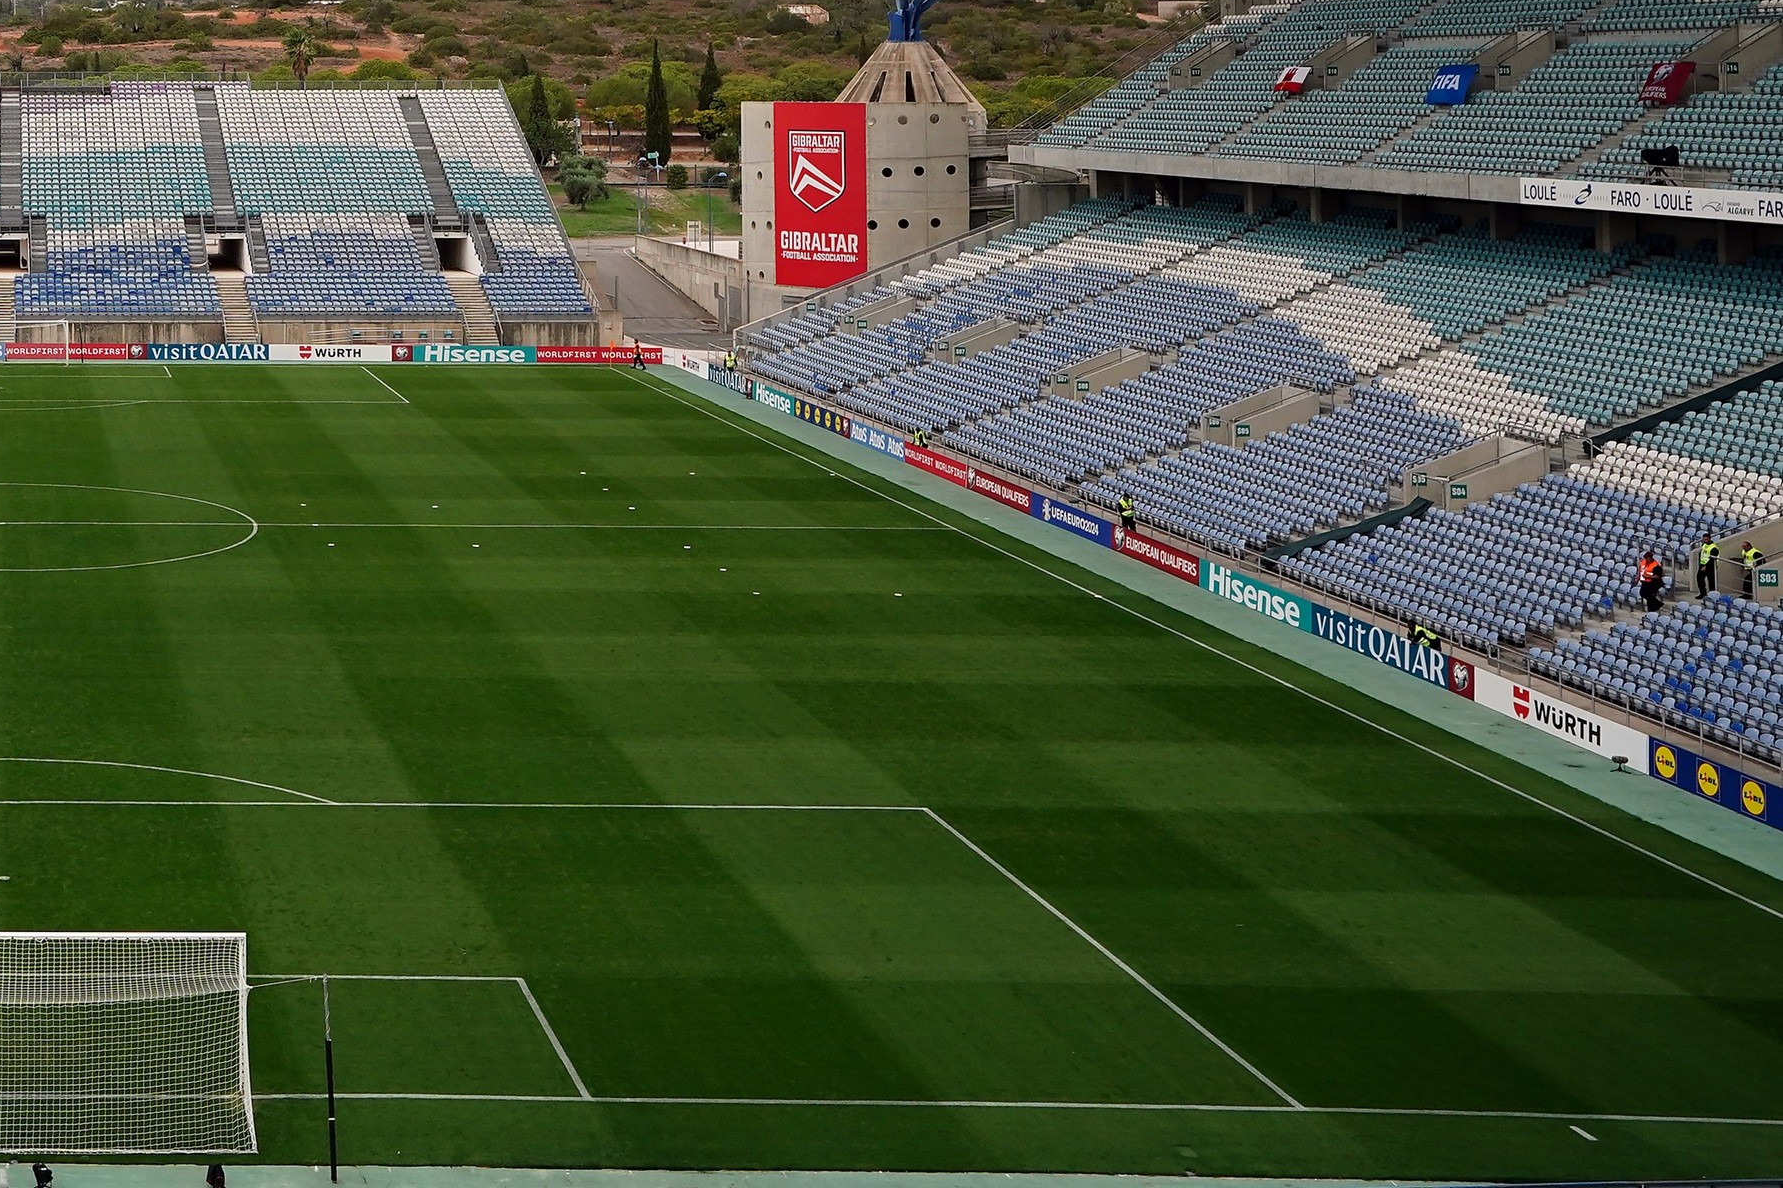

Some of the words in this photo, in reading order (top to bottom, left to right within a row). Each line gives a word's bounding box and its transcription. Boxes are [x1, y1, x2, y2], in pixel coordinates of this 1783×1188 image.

[1431, 74, 1460, 90] FIFA
[792, 134, 840, 148] GIBRALTAR
[1523, 182, 1557, 201] LOULÉ
[1610, 190, 1641, 208] FARO
[1654, 190, 1693, 211] LOULÉ
[1727, 207, 1755, 216] ALGARVE
[780, 230, 858, 253] GIBRALTAR
[782, 250, 812, 261] FOOTBALL
[812, 252, 856, 263] ASSOCIATION
[6, 347, 64, 355] WORLDFIRST
[68, 347, 126, 355] WORLDFIRST
[314, 348, 362, 358] WÜRTH
[424, 345, 526, 362] Hisense
[537, 351, 597, 359] WORLDFIRST
[755, 382, 791, 414] Hisense
[904, 447, 934, 467] WORLDFIRST
[935, 460, 967, 480] WORLDFIRST
[975, 477, 1001, 496] EUROPEAN
[1001, 486, 1030, 508] QUALIFIERS
[1451, 487, 1466, 496] S04
[1125, 536, 1160, 561] EUROPEAN
[1160, 550, 1197, 577] QUALIFIERS
[1759, 573, 1777, 583] S03
[1208, 562, 1300, 628] Hisense
[1534, 699, 1601, 746] WÜRTH
